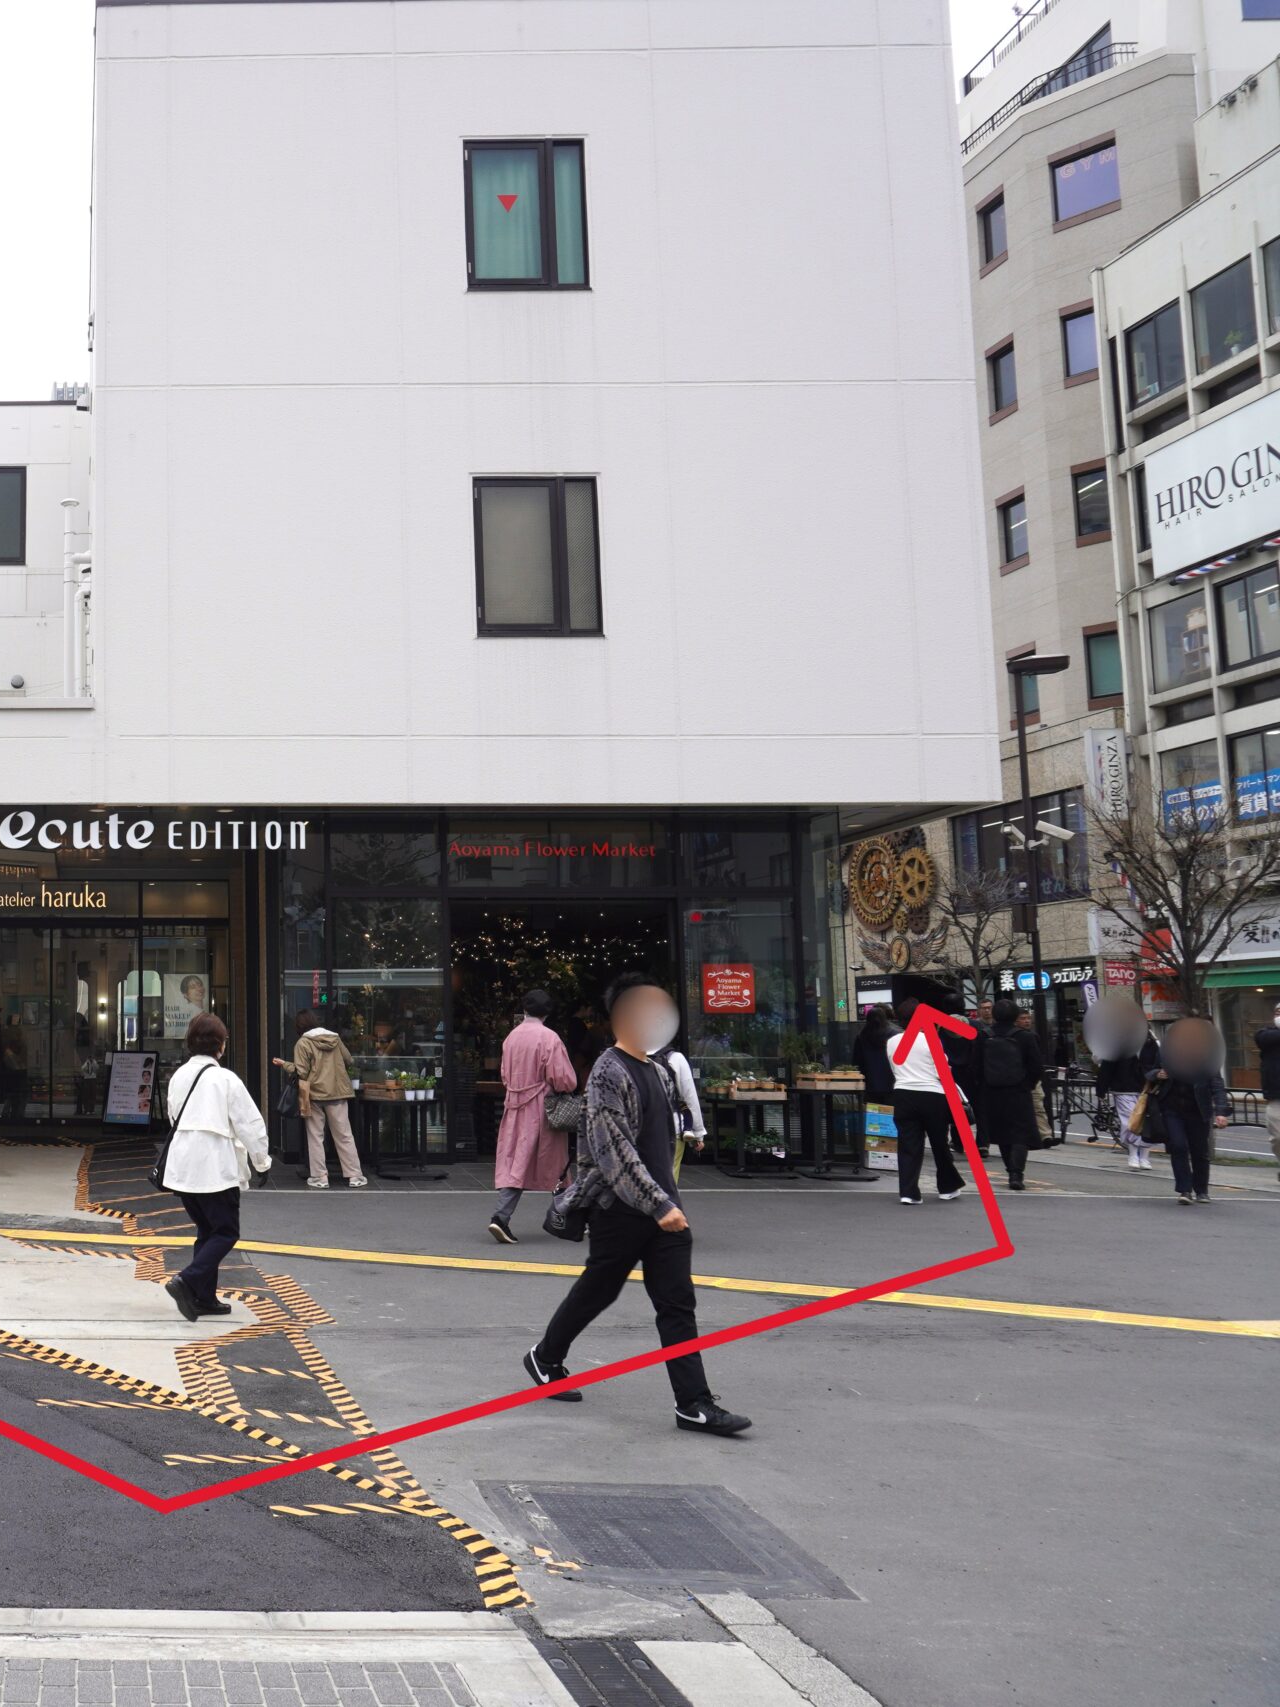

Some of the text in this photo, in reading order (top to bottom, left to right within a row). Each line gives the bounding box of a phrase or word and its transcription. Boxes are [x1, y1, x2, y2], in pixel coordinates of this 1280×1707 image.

[1154, 466, 1226, 524] HIRO
[1164, 508, 1202, 529] HAIR
[1106, 736, 1120, 778] GINZA
[168, 820, 307, 850] EDITION
[448, 841, 656, 859] Aoyama Flower Market
[40, 881, 107, 908] haruka
[716, 977, 742, 985] Aoyama
[1000, 969, 1016, 991] 薬
[1053, 967, 1093, 984] ウエルシア
